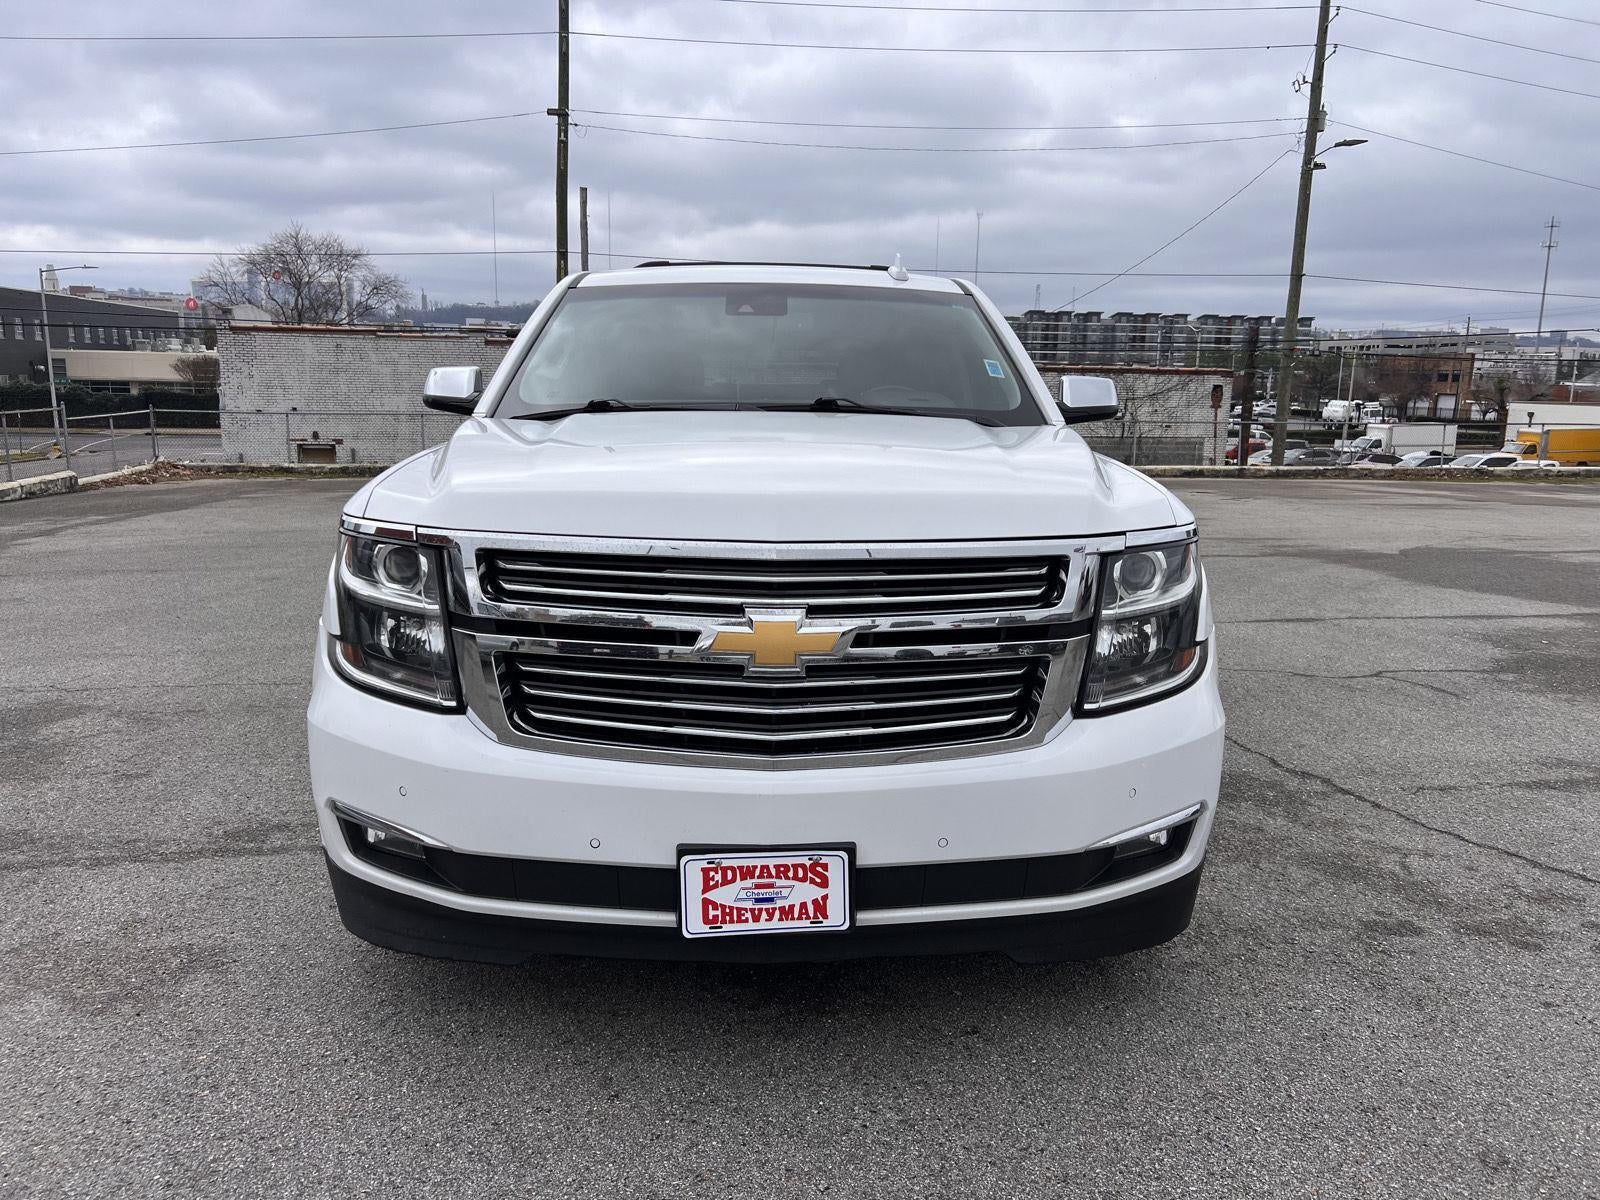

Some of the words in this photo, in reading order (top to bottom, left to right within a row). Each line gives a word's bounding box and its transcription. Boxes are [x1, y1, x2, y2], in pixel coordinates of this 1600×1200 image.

[700, 862, 829, 895] EDWARDS
[745, 890, 783, 898] Chevrolet
[701, 893, 829, 925] CHEVYMAN
